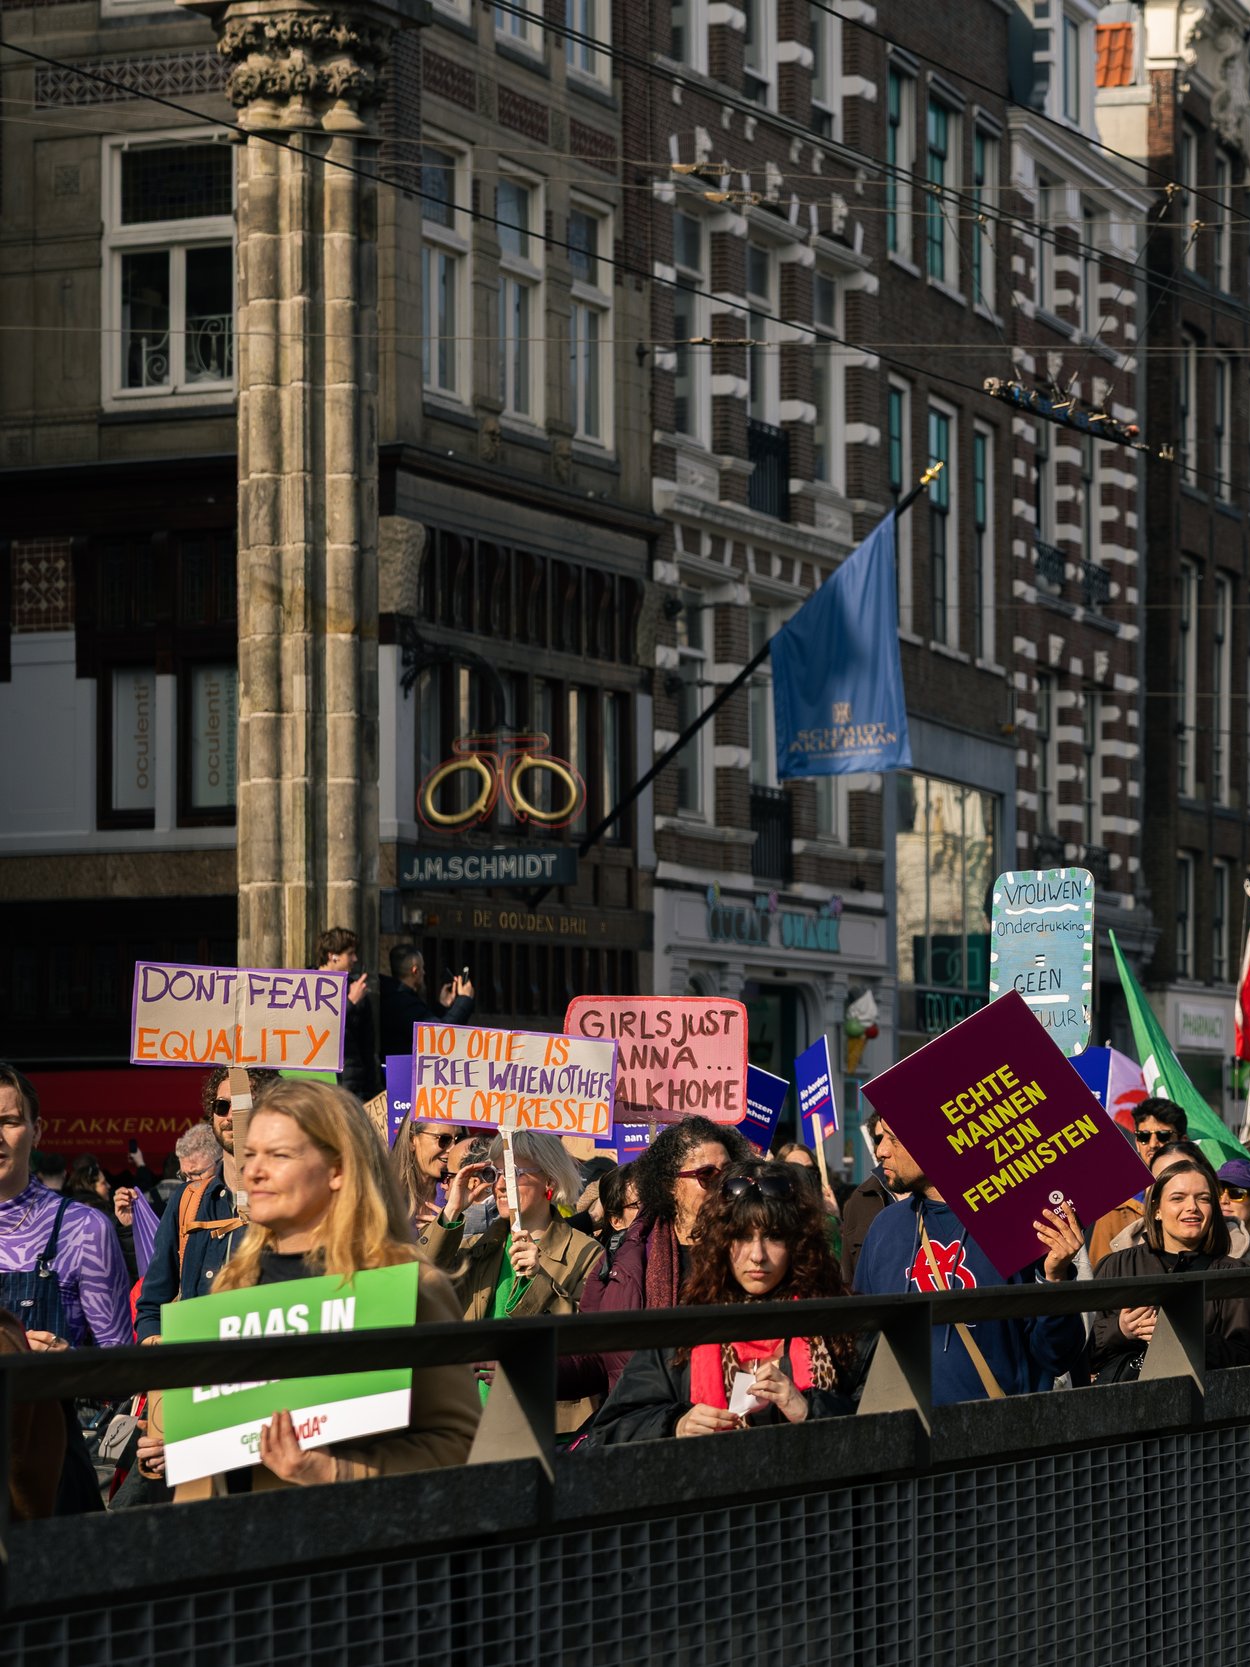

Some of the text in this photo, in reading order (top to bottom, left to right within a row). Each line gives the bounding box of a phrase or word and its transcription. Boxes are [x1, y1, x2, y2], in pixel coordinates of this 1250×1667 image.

[134, 684, 149, 789] oculenti
[205, 682, 220, 787] oculenti
[403, 854, 557, 881] J.M.SCHMIDT
[473, 910, 587, 935] DE GOUDEN BRIL
[248, 974, 339, 1016] FEAR
[1014, 968, 1061, 994] GEEN
[137, 1024, 330, 1065] EQUALITY
[579, 1010, 739, 1047] GIRLS JUST
[544, 1037, 571, 1066] IS
[617, 1045, 698, 1071] ANNA
[416, 1055, 479, 1087] FREE
[488, 1061, 555, 1095] WHEN
[800, 1073, 829, 1100] No borders
[394, 1100, 411, 1110] Gee
[415, 1087, 462, 1119] ARE
[470, 1091, 610, 1134] OPPRESSED
[614, 1076, 739, 1111] ALK HOME
[747, 1098, 773, 1115] enzen
[801, 1084, 829, 1112] to equality
[940, 1064, 1020, 1125] ECHTE
[68, 1117, 206, 1133] AKKERMA
[746, 1108, 771, 1123] kheid
[946, 1080, 1047, 1155] MANNEN
[624, 1134, 643, 1142] aan
[985, 1118, 1041, 1164] ZIJN
[962, 1114, 1100, 1212] FEMINISTEN
[320, 1296, 356, 1332] IN
